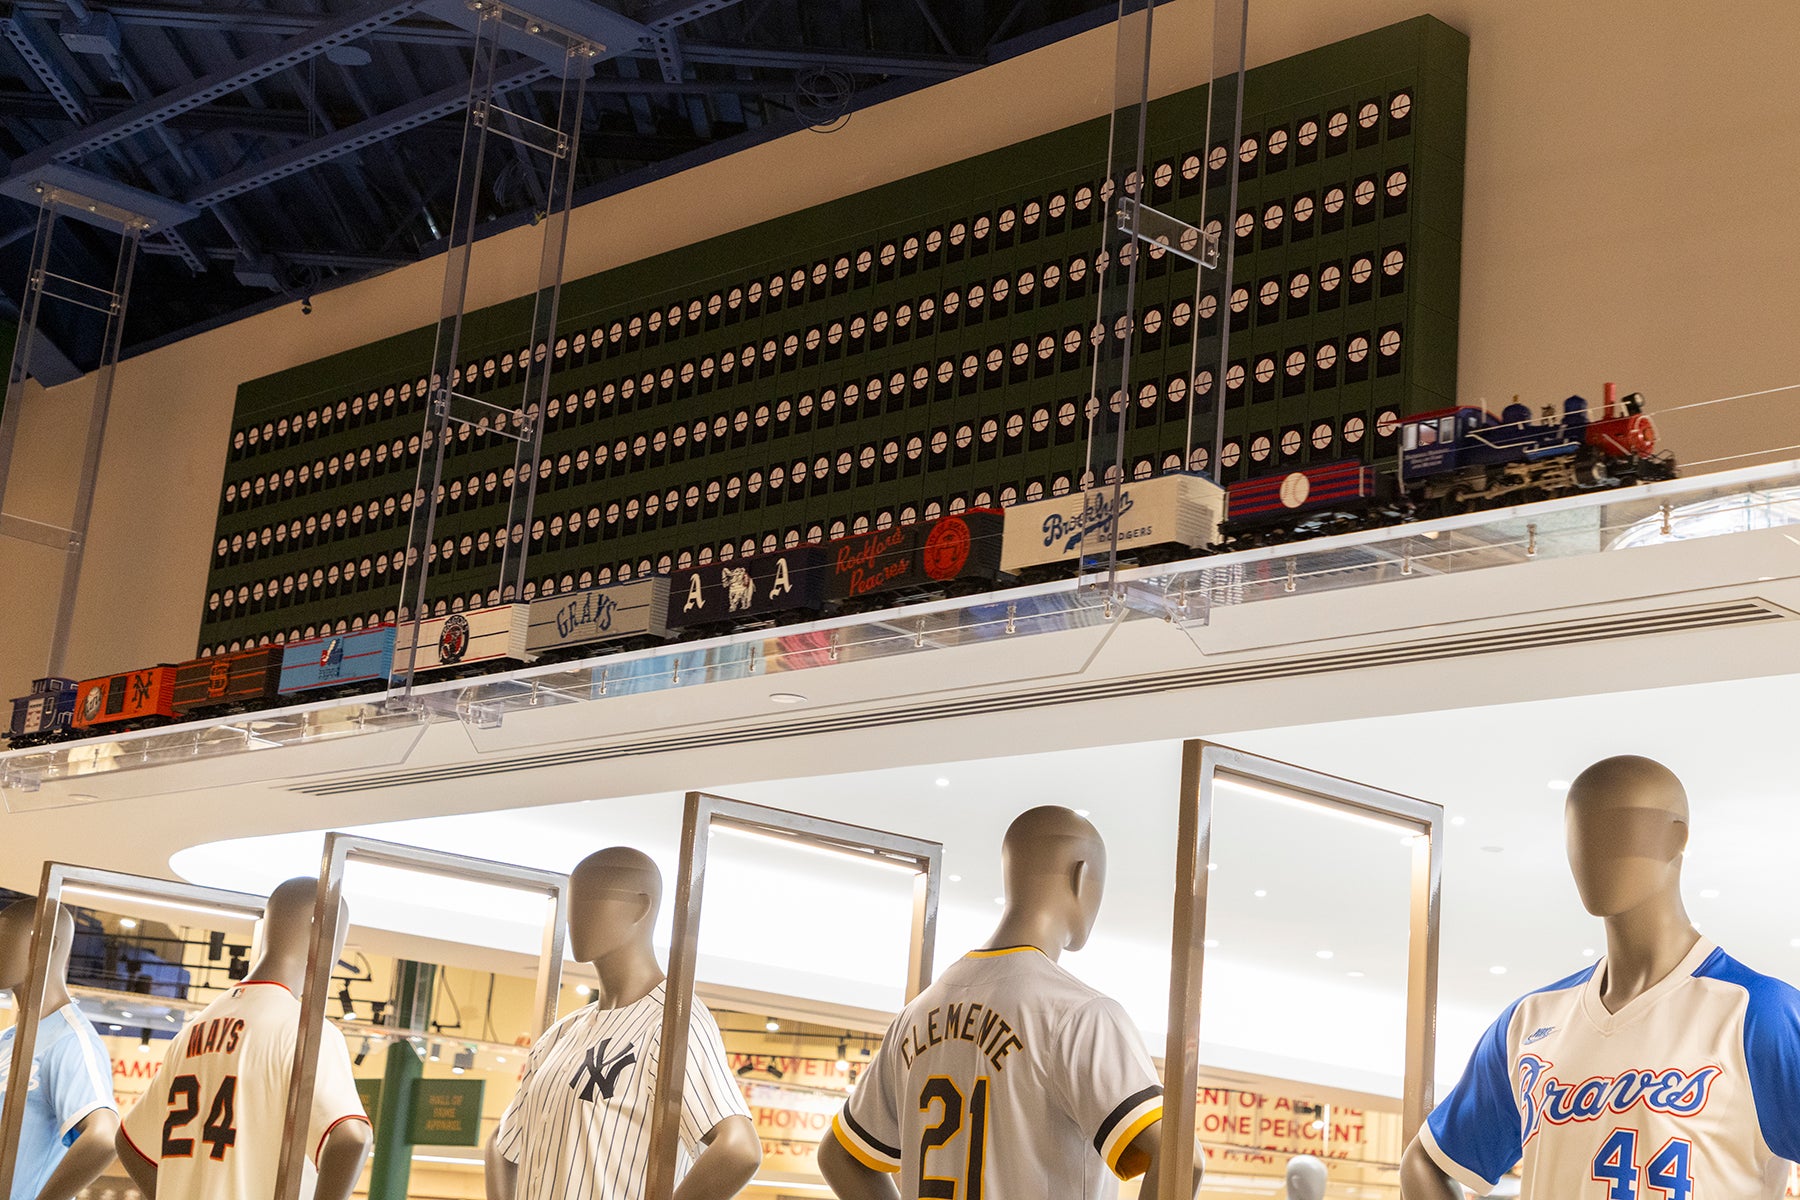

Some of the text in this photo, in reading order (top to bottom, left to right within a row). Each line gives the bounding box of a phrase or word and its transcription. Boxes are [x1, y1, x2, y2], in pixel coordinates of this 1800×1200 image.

[1100, 526, 1153, 543] DODGERS
[683, 557, 793, 613] A A
[556, 592, 618, 639] GRAYS
[186, 1017, 245, 1059] MAYS
[901, 1002, 1024, 1072] CLEMENTE
[111, 1058, 163, 1079] AM
[569, 1037, 637, 1102] NY
[161, 1074, 237, 1162] 24
[758, 1107, 832, 1130] HONO
[1204, 1113, 1251, 1135] ONE
[1518, 1053, 1723, 1149] Braves
[917, 1074, 990, 1200] 21
[1591, 1127, 1694, 1200] 44
